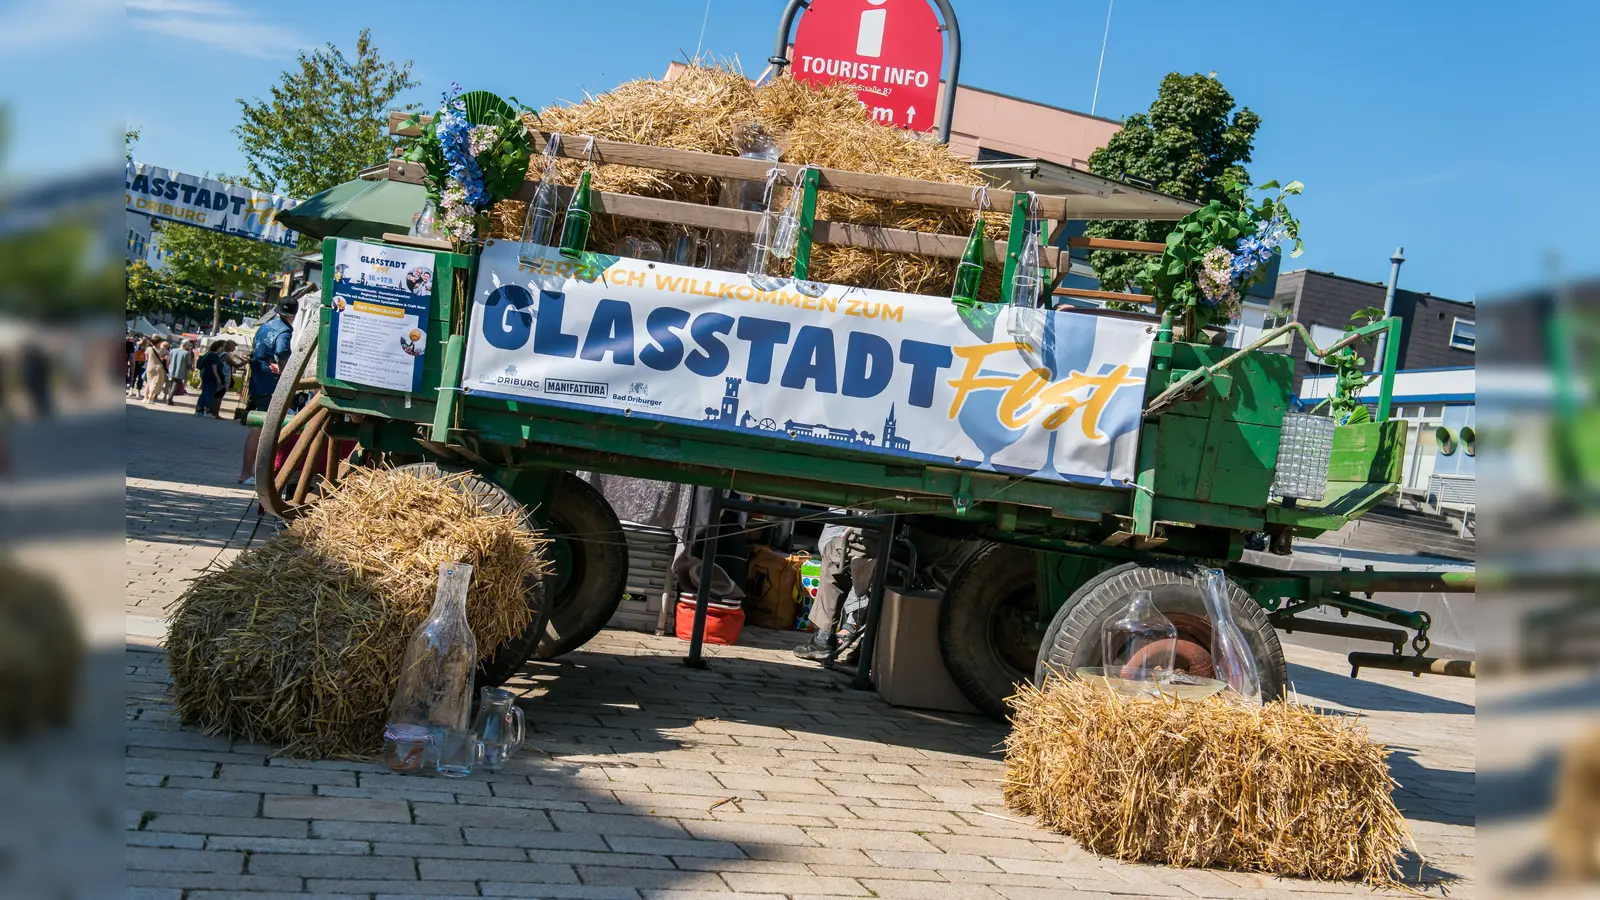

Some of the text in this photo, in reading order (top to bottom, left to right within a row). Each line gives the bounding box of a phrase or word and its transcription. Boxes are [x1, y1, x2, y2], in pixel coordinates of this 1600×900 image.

[802, 55, 881, 82] TOURIST
[884, 66, 929, 88] INFO
[883, 87, 892, 96] 87
[135, 197, 207, 223] DRIBURG
[360, 255, 407, 269] GLASSTADT
[655, 274, 838, 313] WILLKOMMEN
[844, 299, 905, 323] ZUM
[482, 283, 1144, 440] GLASSTADT Fest
[547, 381, 606, 396] MANIFATTURA
[612, 393, 627, 401] Bad
[627, 395, 663, 407] Driburger
